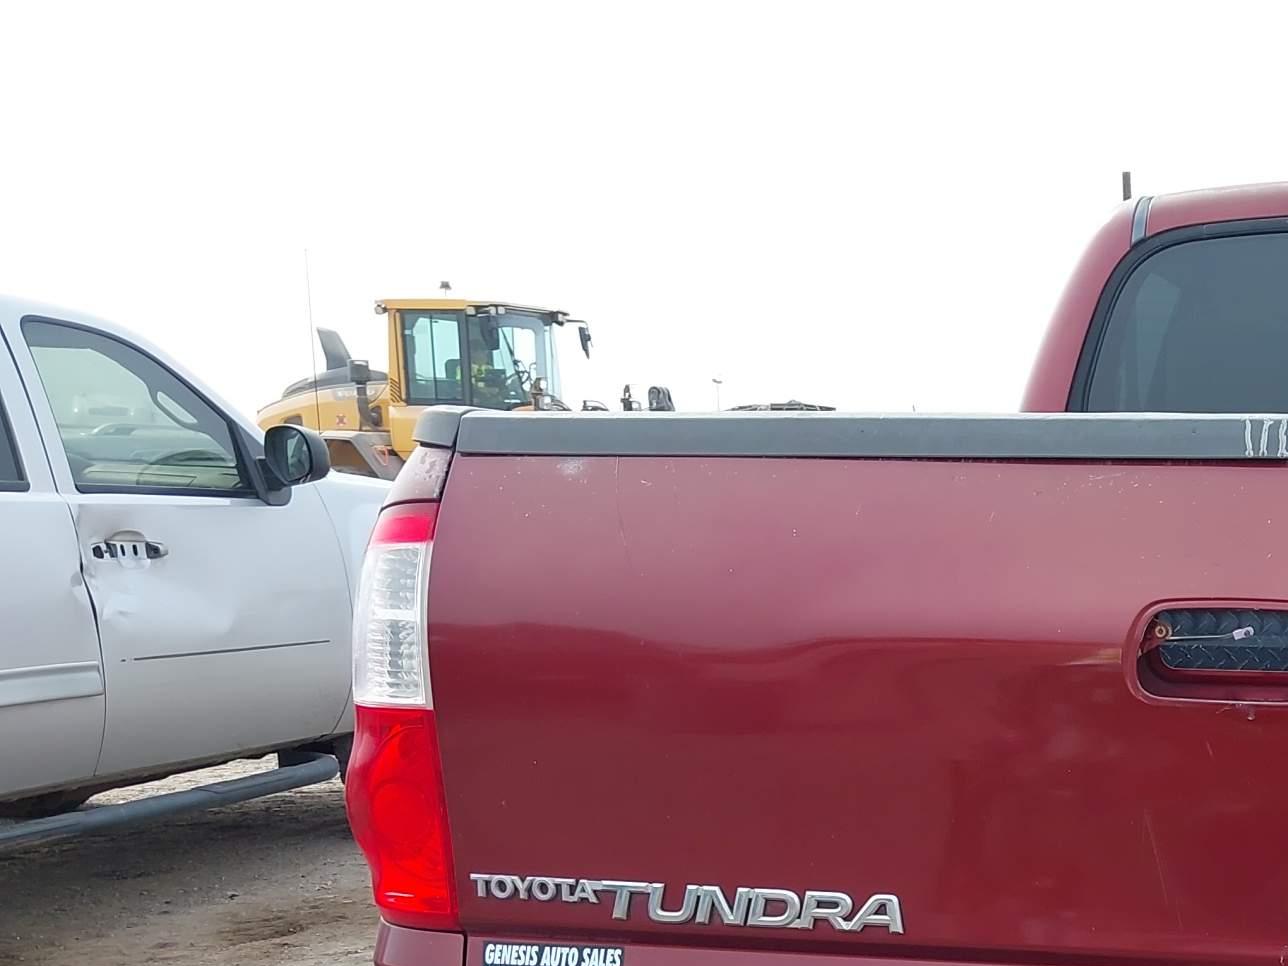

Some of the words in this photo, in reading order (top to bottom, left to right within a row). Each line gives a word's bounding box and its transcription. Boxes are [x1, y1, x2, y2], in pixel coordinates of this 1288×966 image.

[470, 873, 600, 904] TOYOTA
[602, 880, 905, 934] TUNDRA
[485, 943, 539, 966] GENESIS
